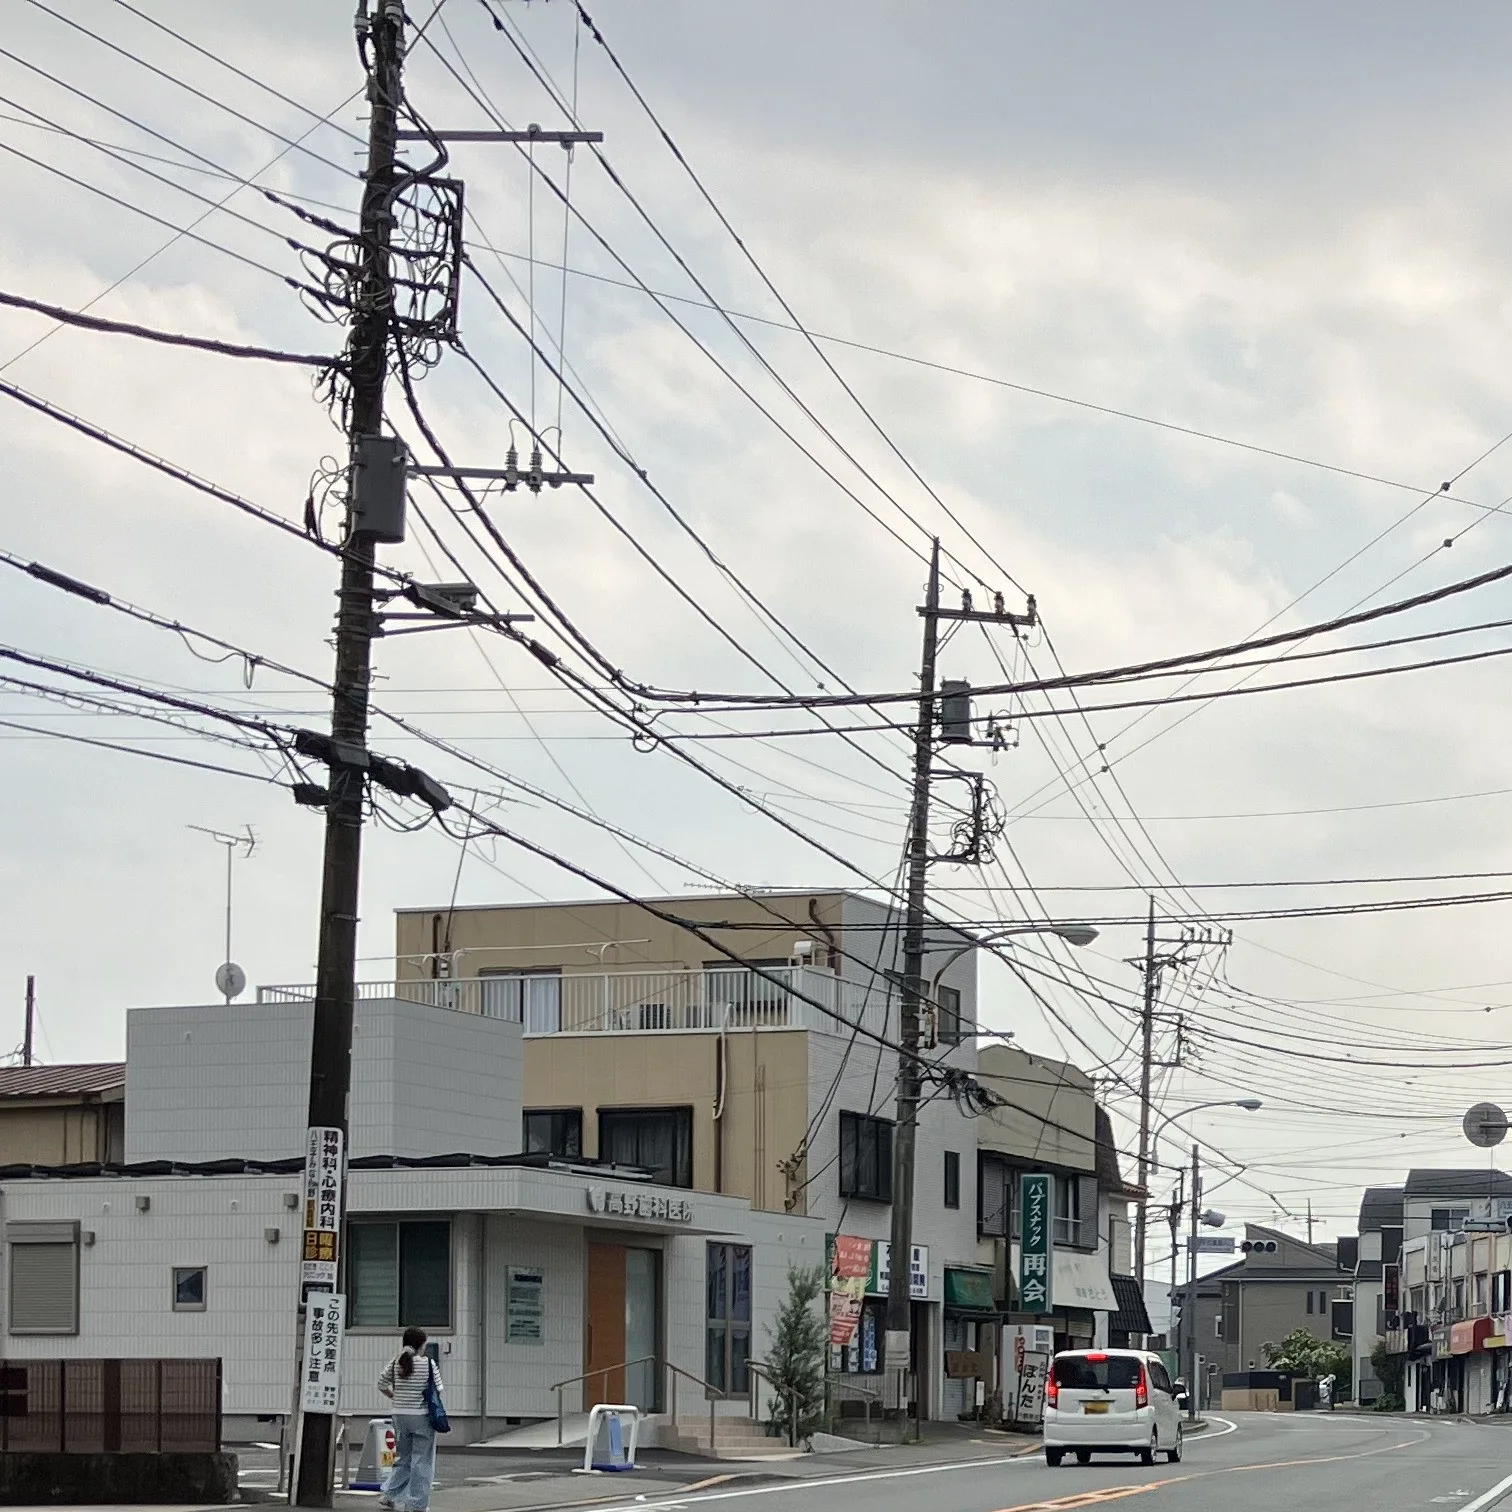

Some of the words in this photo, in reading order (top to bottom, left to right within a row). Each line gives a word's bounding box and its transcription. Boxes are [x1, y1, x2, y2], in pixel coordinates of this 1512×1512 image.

[320, 1130, 338, 1229] 精神科・心療内科
[1023, 1252, 1047, 1303] 再会
[308, 1307, 325, 1383] 事故多し注意
[324, 1298, 340, 1373] この先交差点
